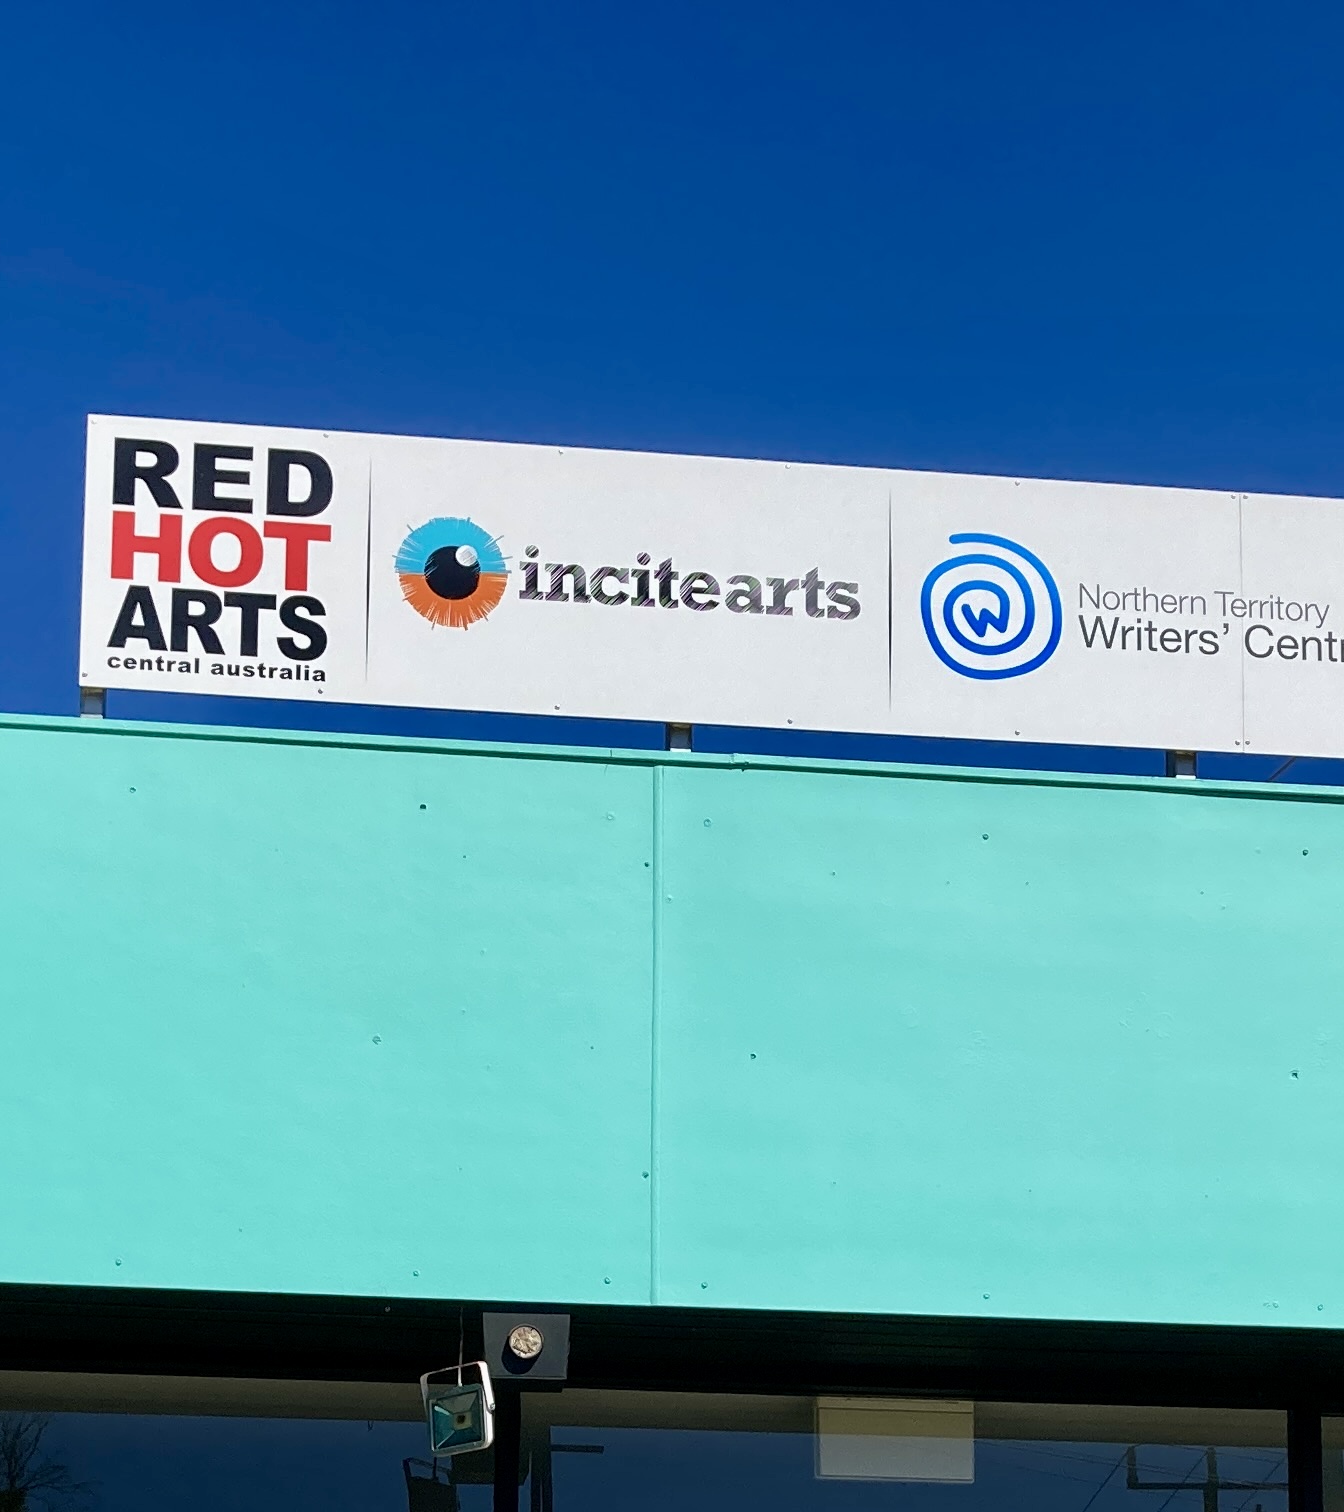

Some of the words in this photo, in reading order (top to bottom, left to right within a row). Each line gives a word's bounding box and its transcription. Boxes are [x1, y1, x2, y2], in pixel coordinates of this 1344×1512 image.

[112, 436, 334, 518] RED
[109, 510, 332, 592] HOT
[107, 584, 329, 662] ARTS
[1077, 582, 1208, 616] Northern
[1213, 590, 1331, 630] Territory
[1077, 614, 1231, 656] Writers’
[106, 655, 201, 676] central
[210, 661, 327, 684] australia
